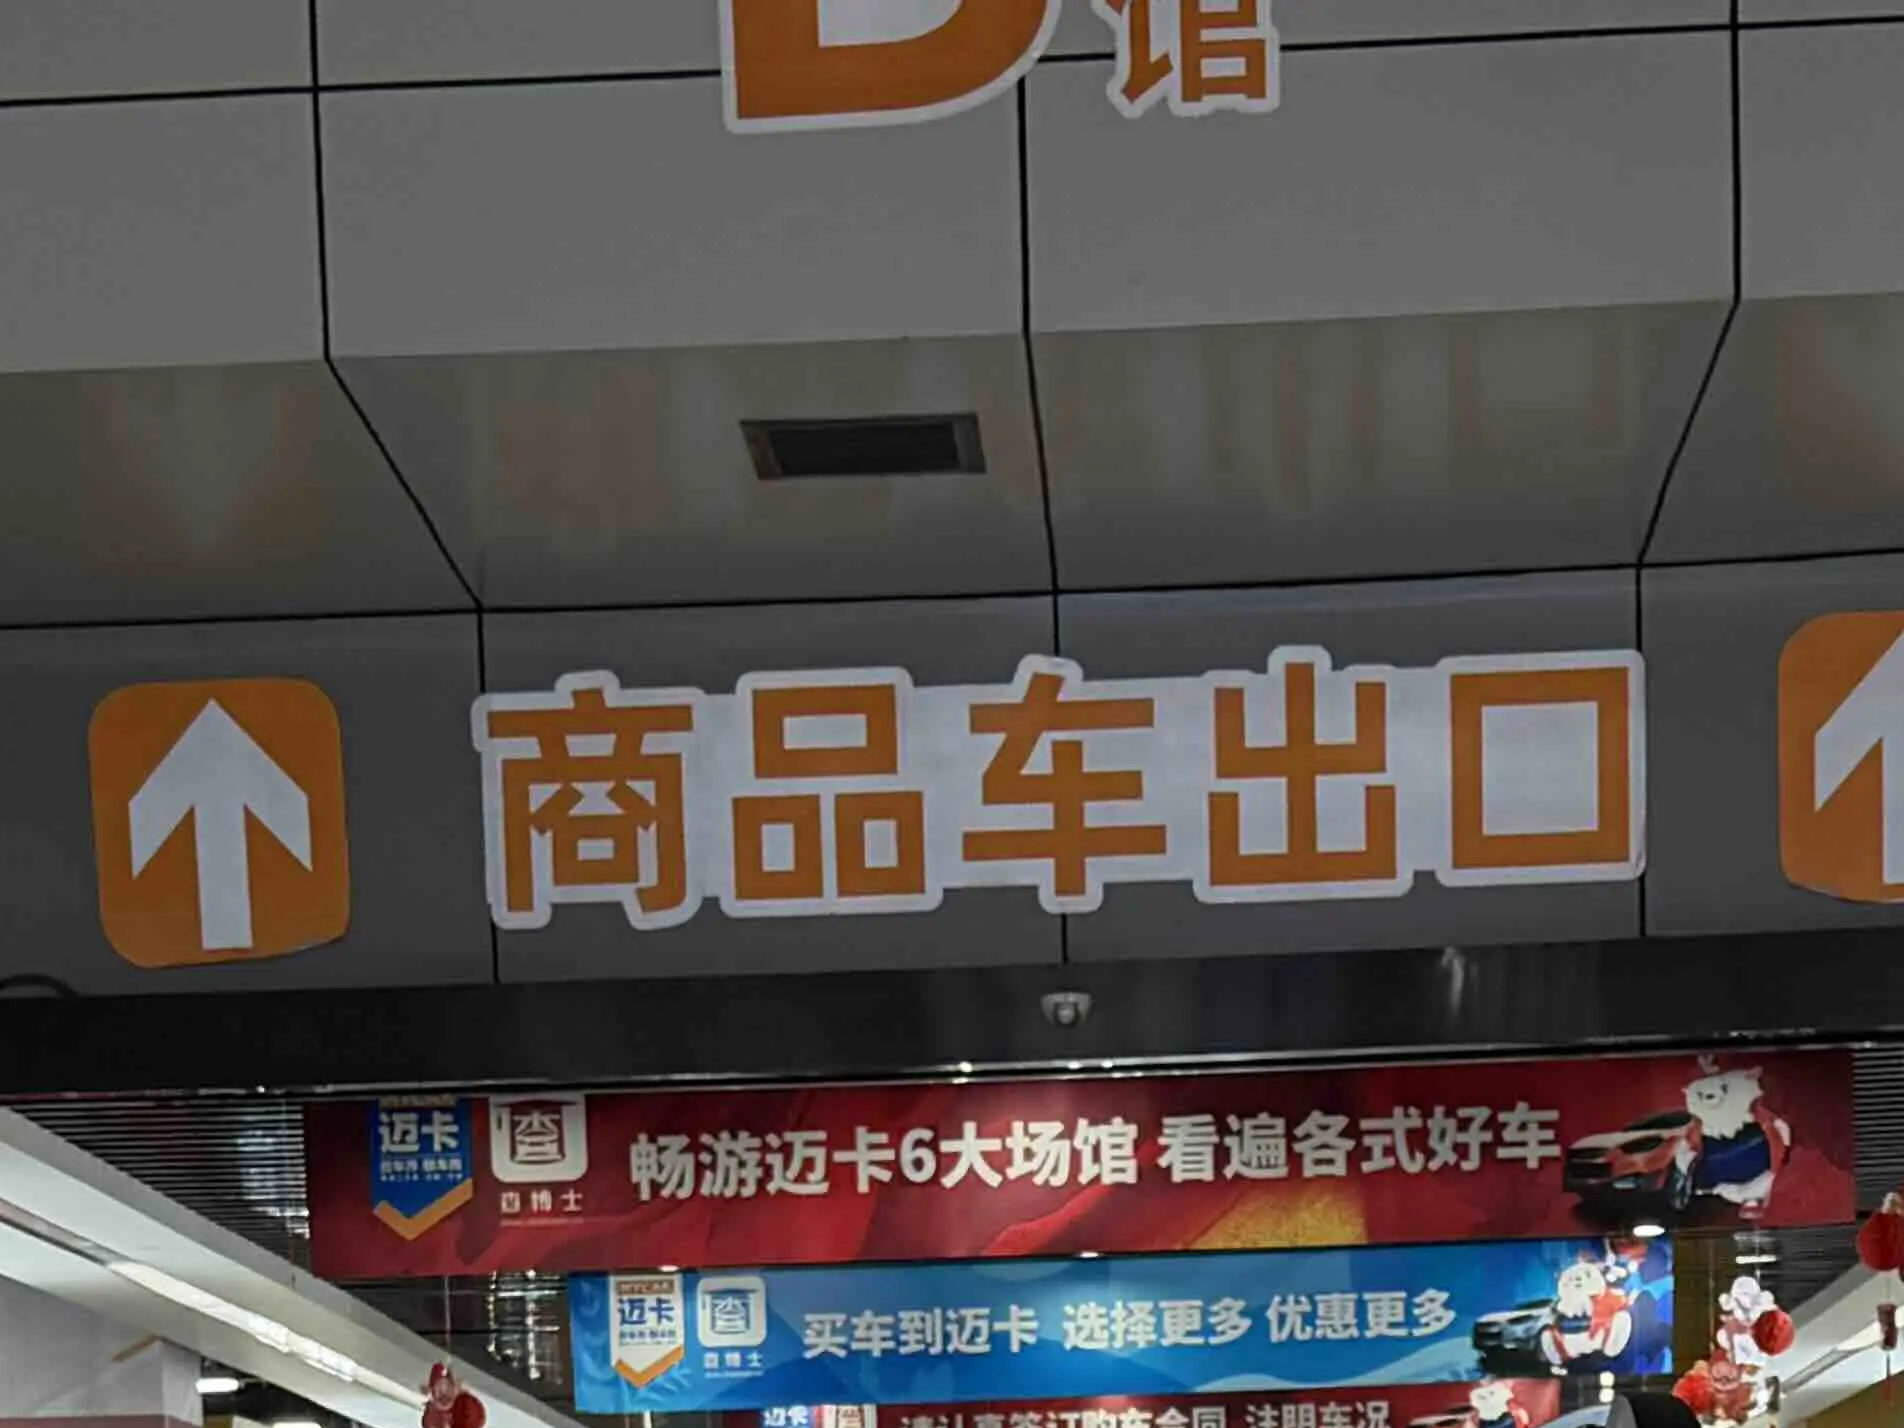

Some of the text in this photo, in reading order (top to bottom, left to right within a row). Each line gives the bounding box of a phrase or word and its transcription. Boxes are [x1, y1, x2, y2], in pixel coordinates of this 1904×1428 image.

[486, 658, 1634, 916] 商品车出口
[379, 1110, 459, 1153] 迈卡
[629, 1101, 1561, 1201] 畅游迈卡6大场馆 看遍各式好车
[617, 1297, 675, 1326] 迈卡
[802, 1288, 1457, 1360] 买车到迈卡 选择更多 优惠更多
